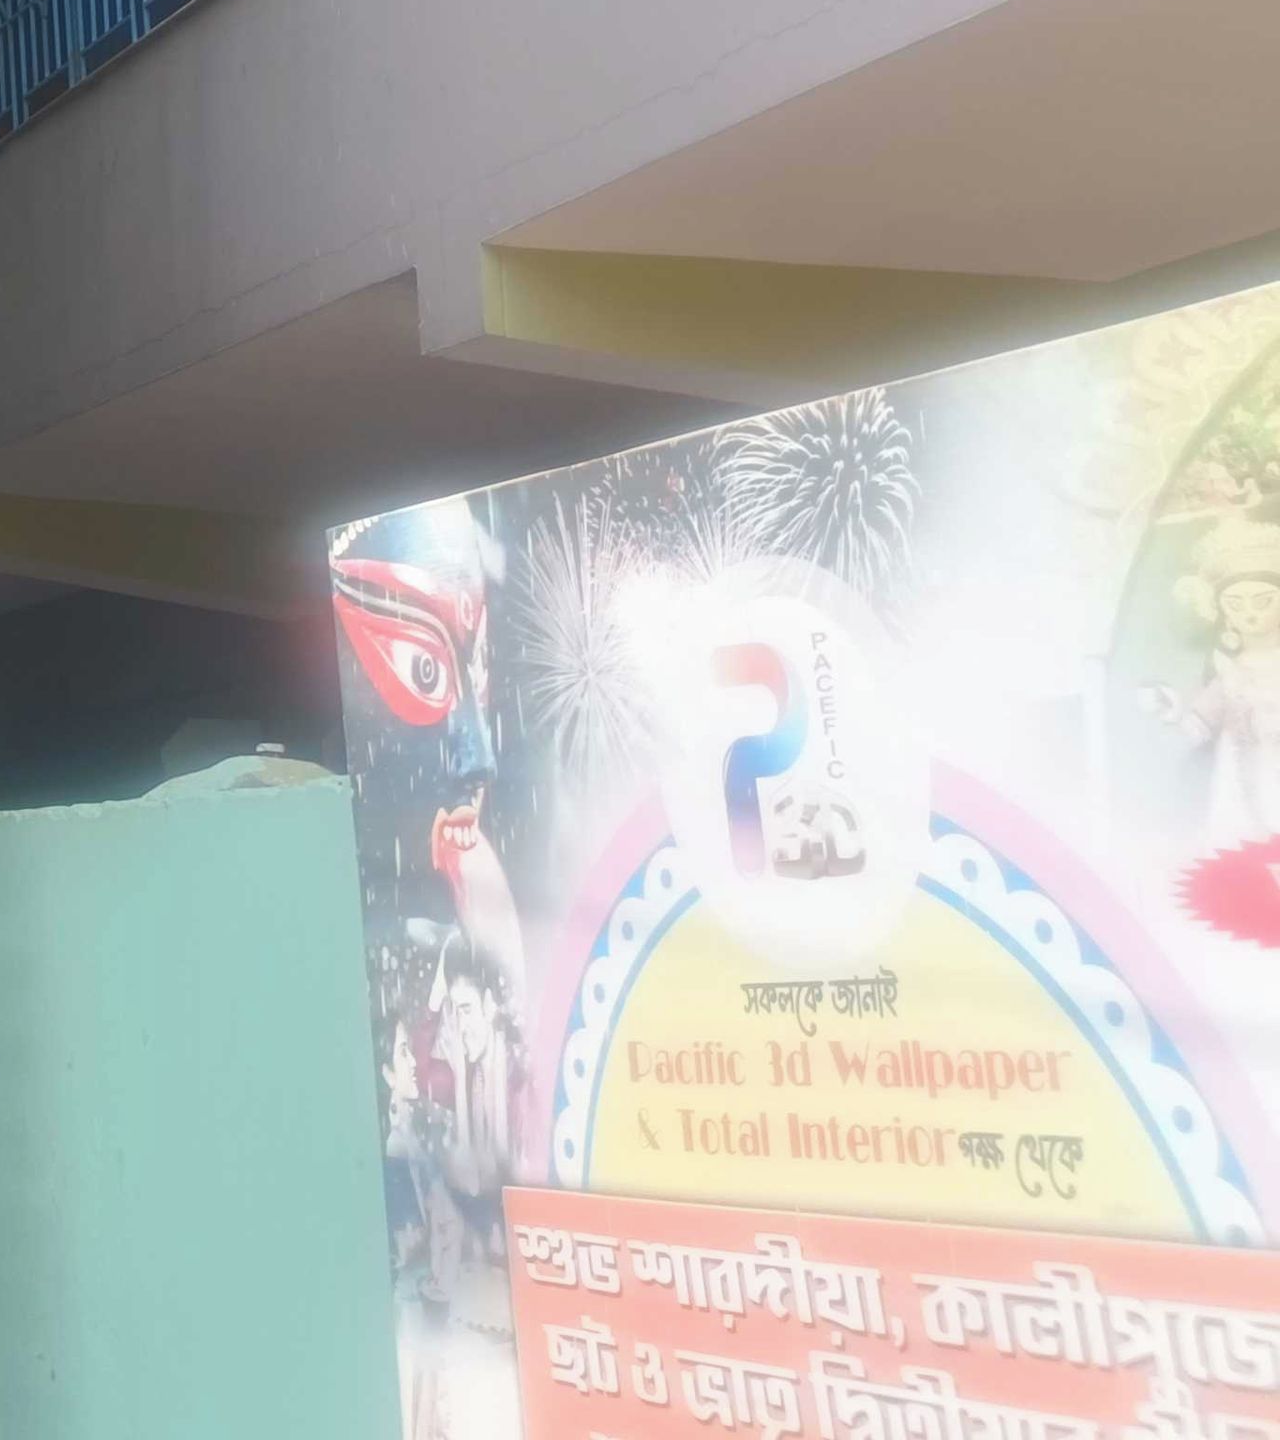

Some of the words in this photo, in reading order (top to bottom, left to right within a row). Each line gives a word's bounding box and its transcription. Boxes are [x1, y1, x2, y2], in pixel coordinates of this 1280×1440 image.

[810, 631, 846, 780] PACEFIC
[741, 980, 823, 1037] সকলকে
[829, 965, 899, 1019] জানাই
[627, 1039, 747, 1087] Pacific
[763, 1039, 813, 1088] 3d
[827, 1039, 1074, 1100] Wallpaper
[637, 1107, 661, 1151] &
[675, 1107, 771, 1157] Total
[787, 1110, 958, 1167] Interior
[1014, 1133, 1085, 1200] থেকে
[514, 1224, 622, 1295] শুভ
[630, 1342, 669, 1405] ও
